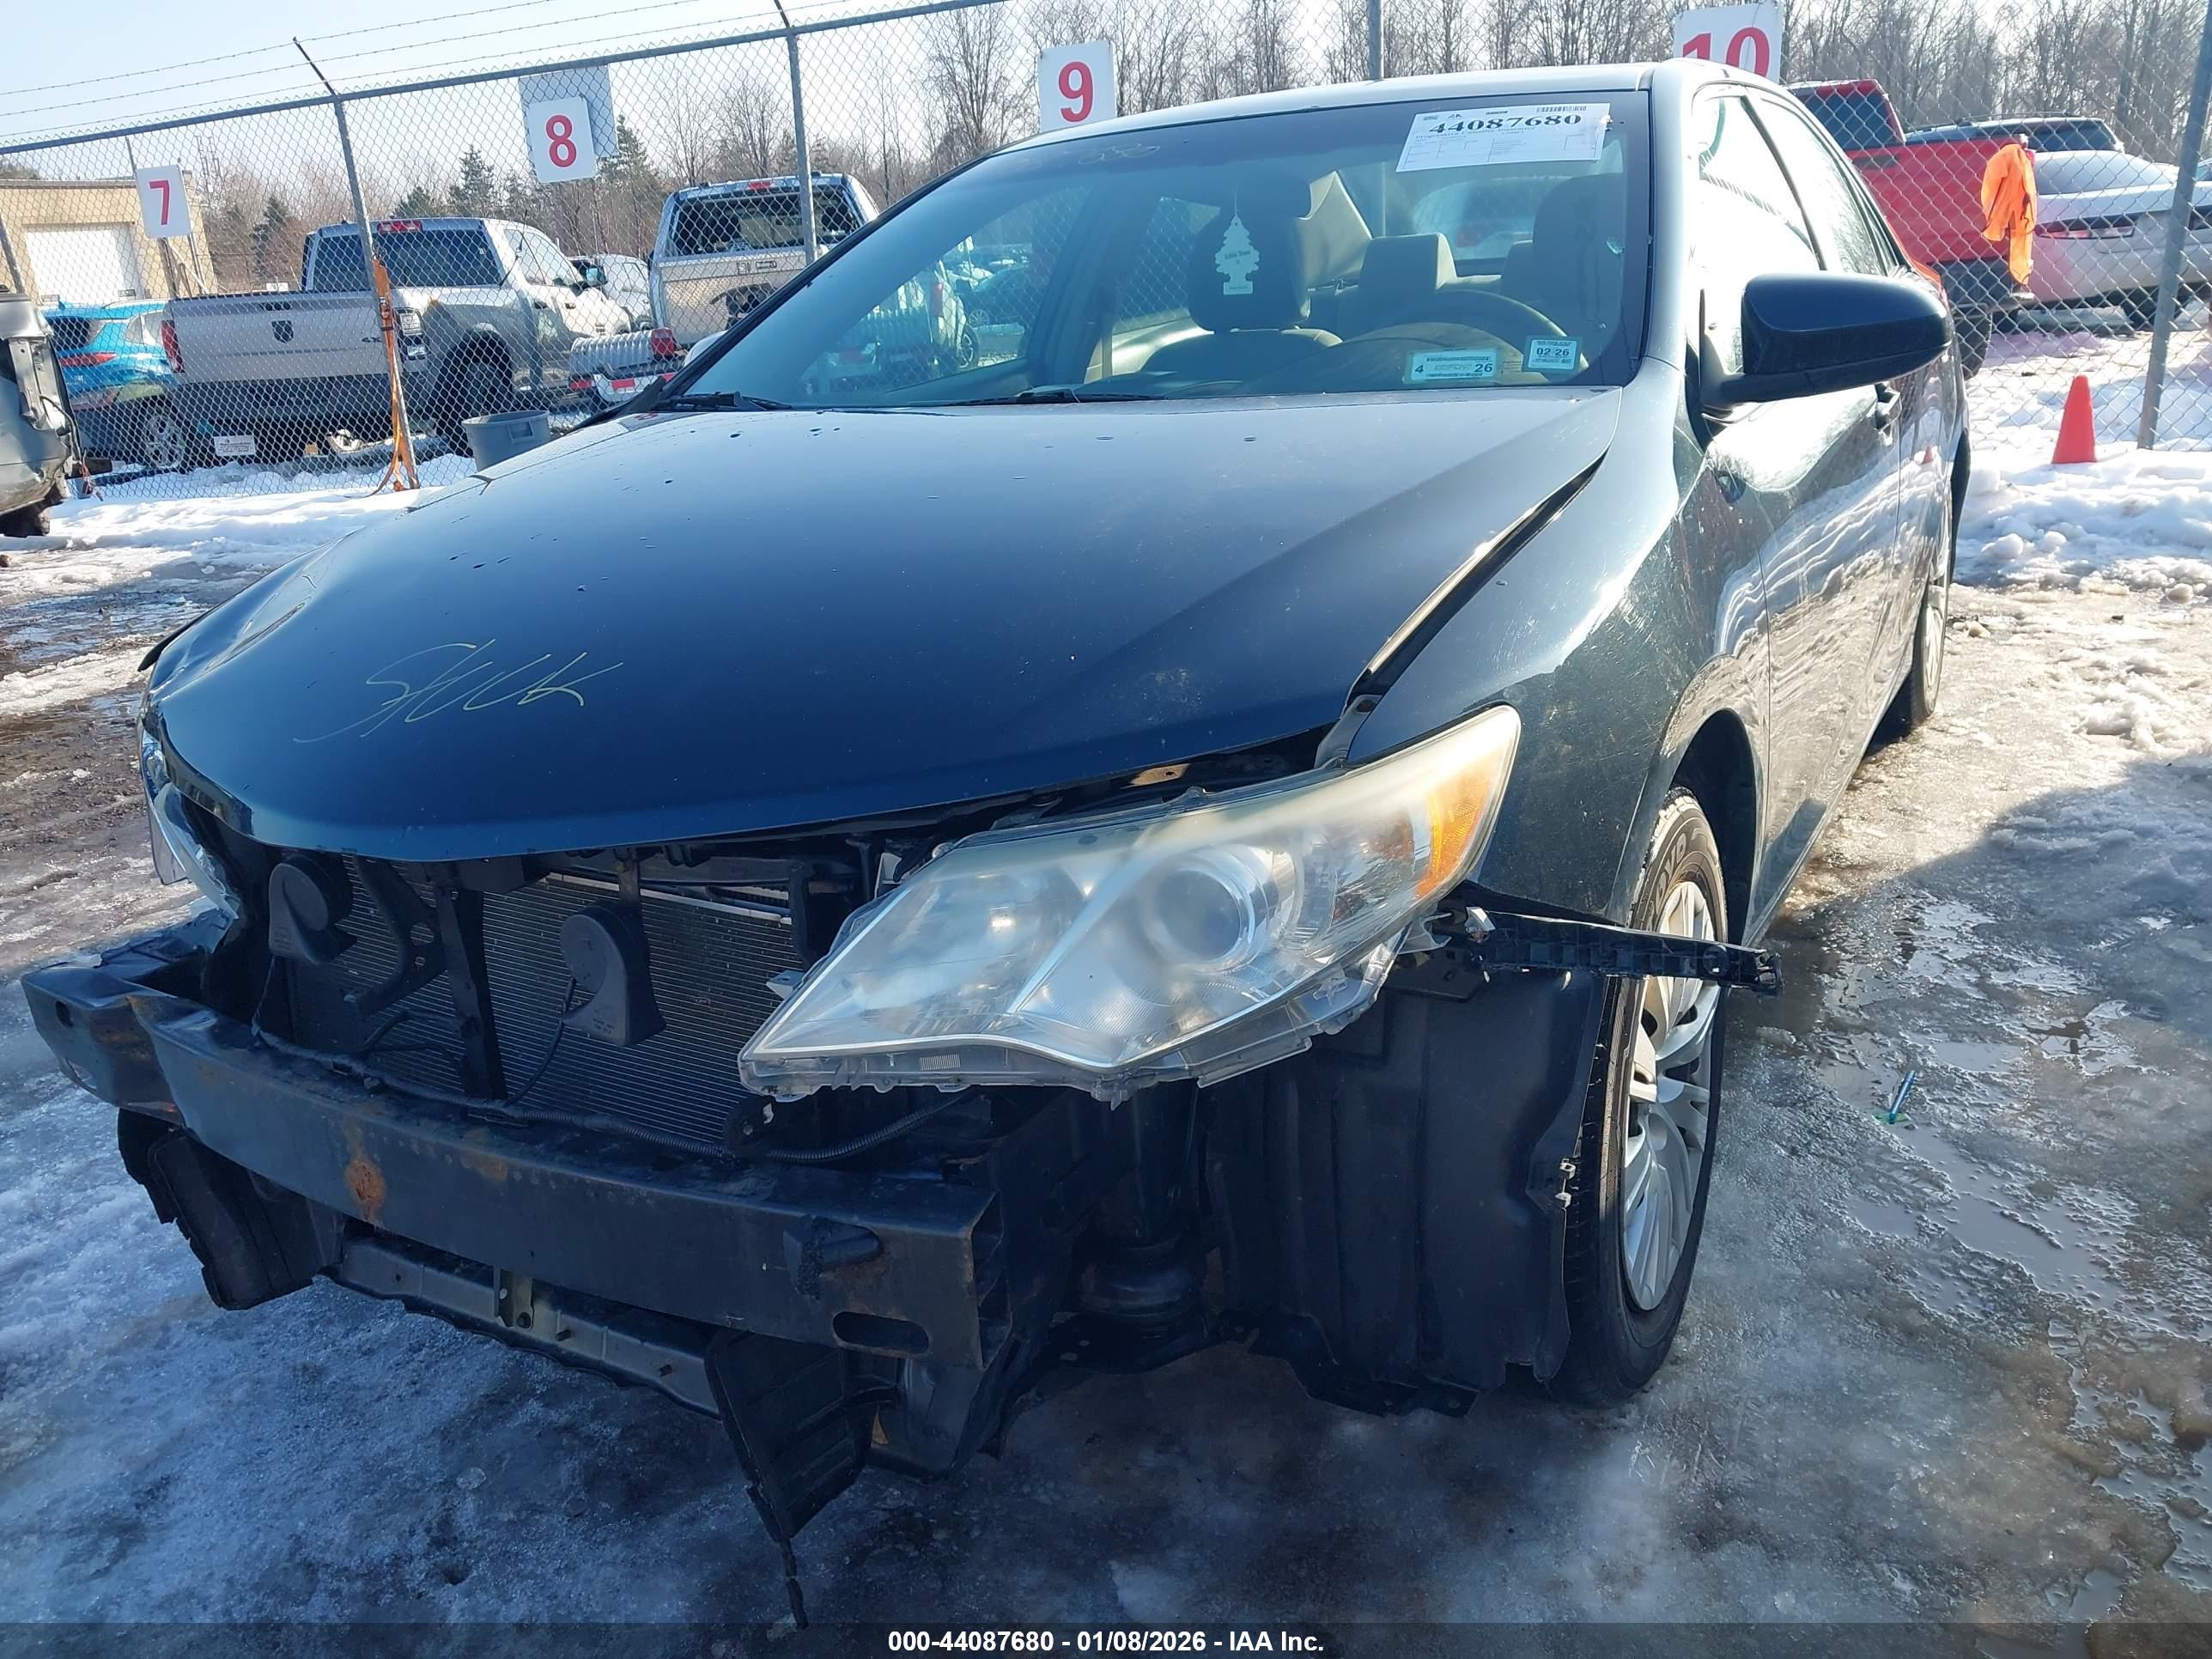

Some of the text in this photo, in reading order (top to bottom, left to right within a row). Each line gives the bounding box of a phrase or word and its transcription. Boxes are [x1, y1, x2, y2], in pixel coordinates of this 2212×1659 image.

[1058, 61, 1094, 123] 9
[545, 114, 577, 167] 8
[1428, 114, 1582, 134] 44087680
[149, 179, 170, 226] 7
[1536, 347, 1570, 356] 02 26
[1414, 363, 1493, 374] 4 26
